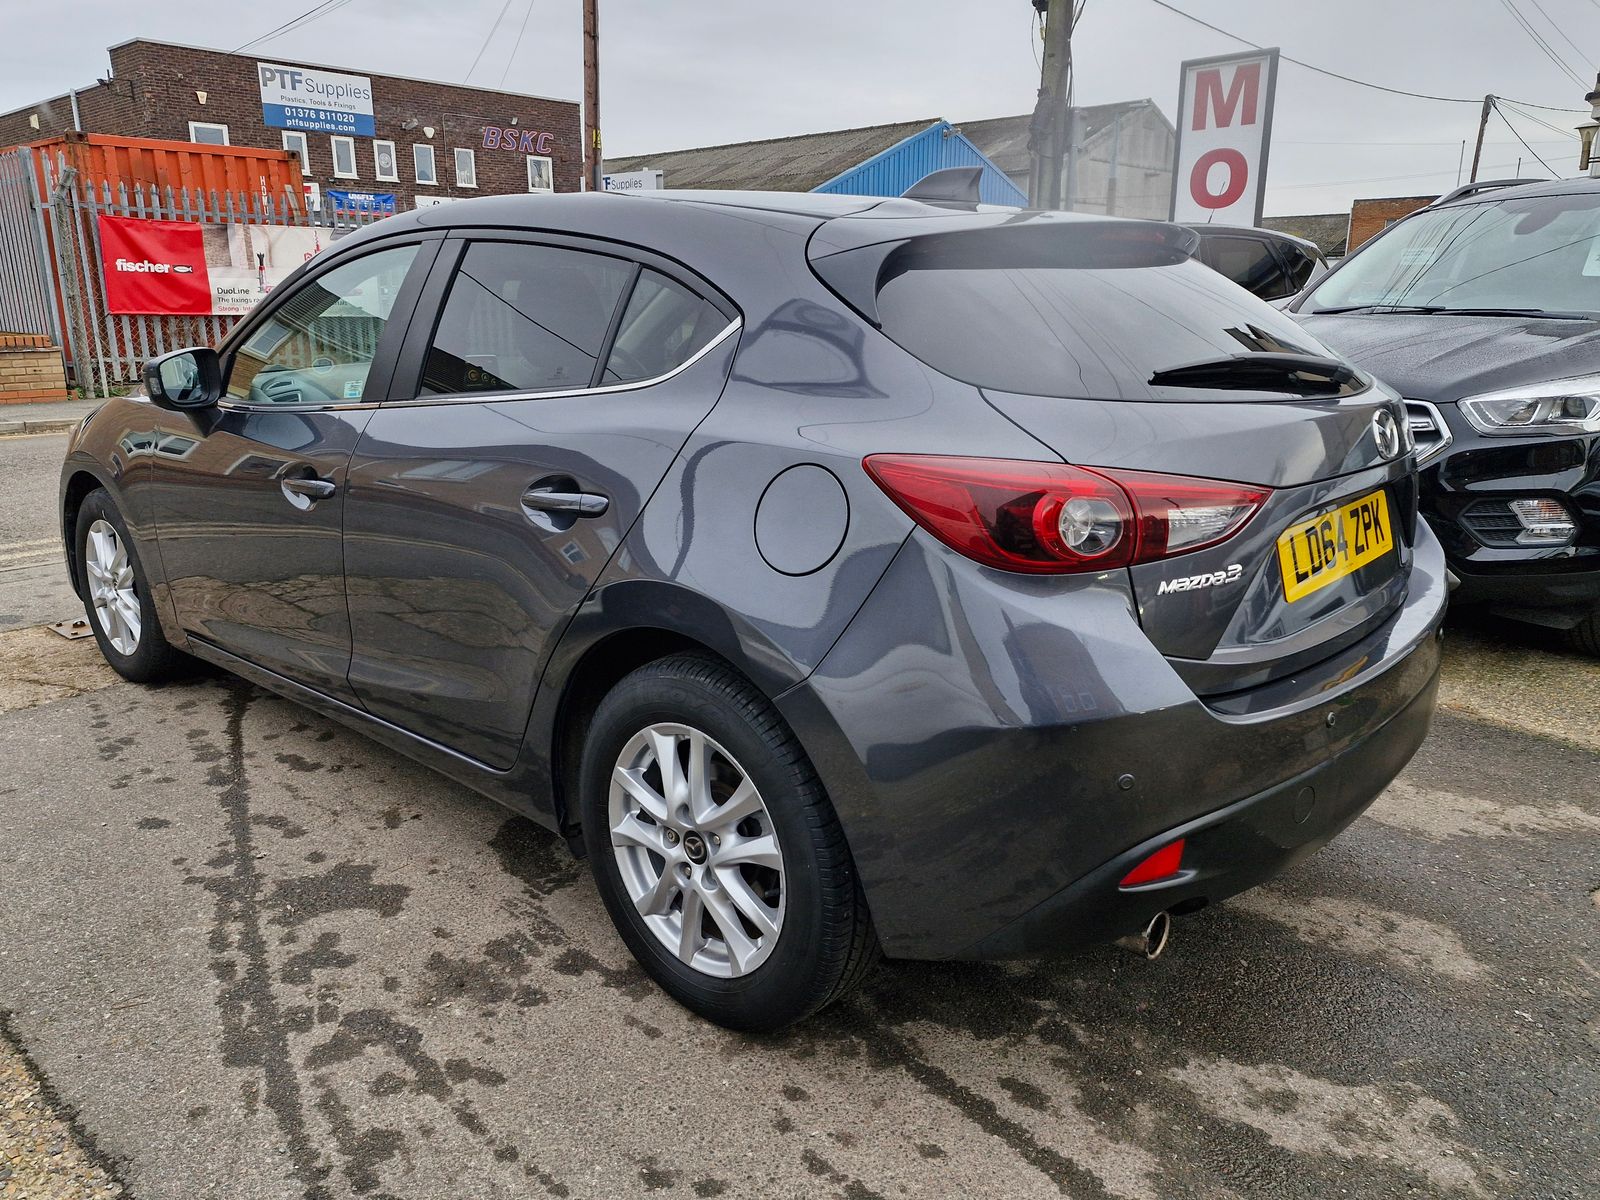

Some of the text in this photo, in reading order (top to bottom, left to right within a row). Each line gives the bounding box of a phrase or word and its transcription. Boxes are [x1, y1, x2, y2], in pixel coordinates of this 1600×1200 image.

[260, 66, 371, 100] PTF Supplies
[309, 98, 326, 107] Tools
[333, 101, 357, 110] Fixings
[284, 107, 355, 123] 01376 811020
[286, 118, 356, 132] ptfsupplies.com
[482, 126, 555, 154] BSKC
[611, 178, 643, 190] Supplies
[115, 258, 171, 274] fischer
[216, 287, 250, 295] DuoLine
[1288, 497, 1386, 585] LD64 ZPK
